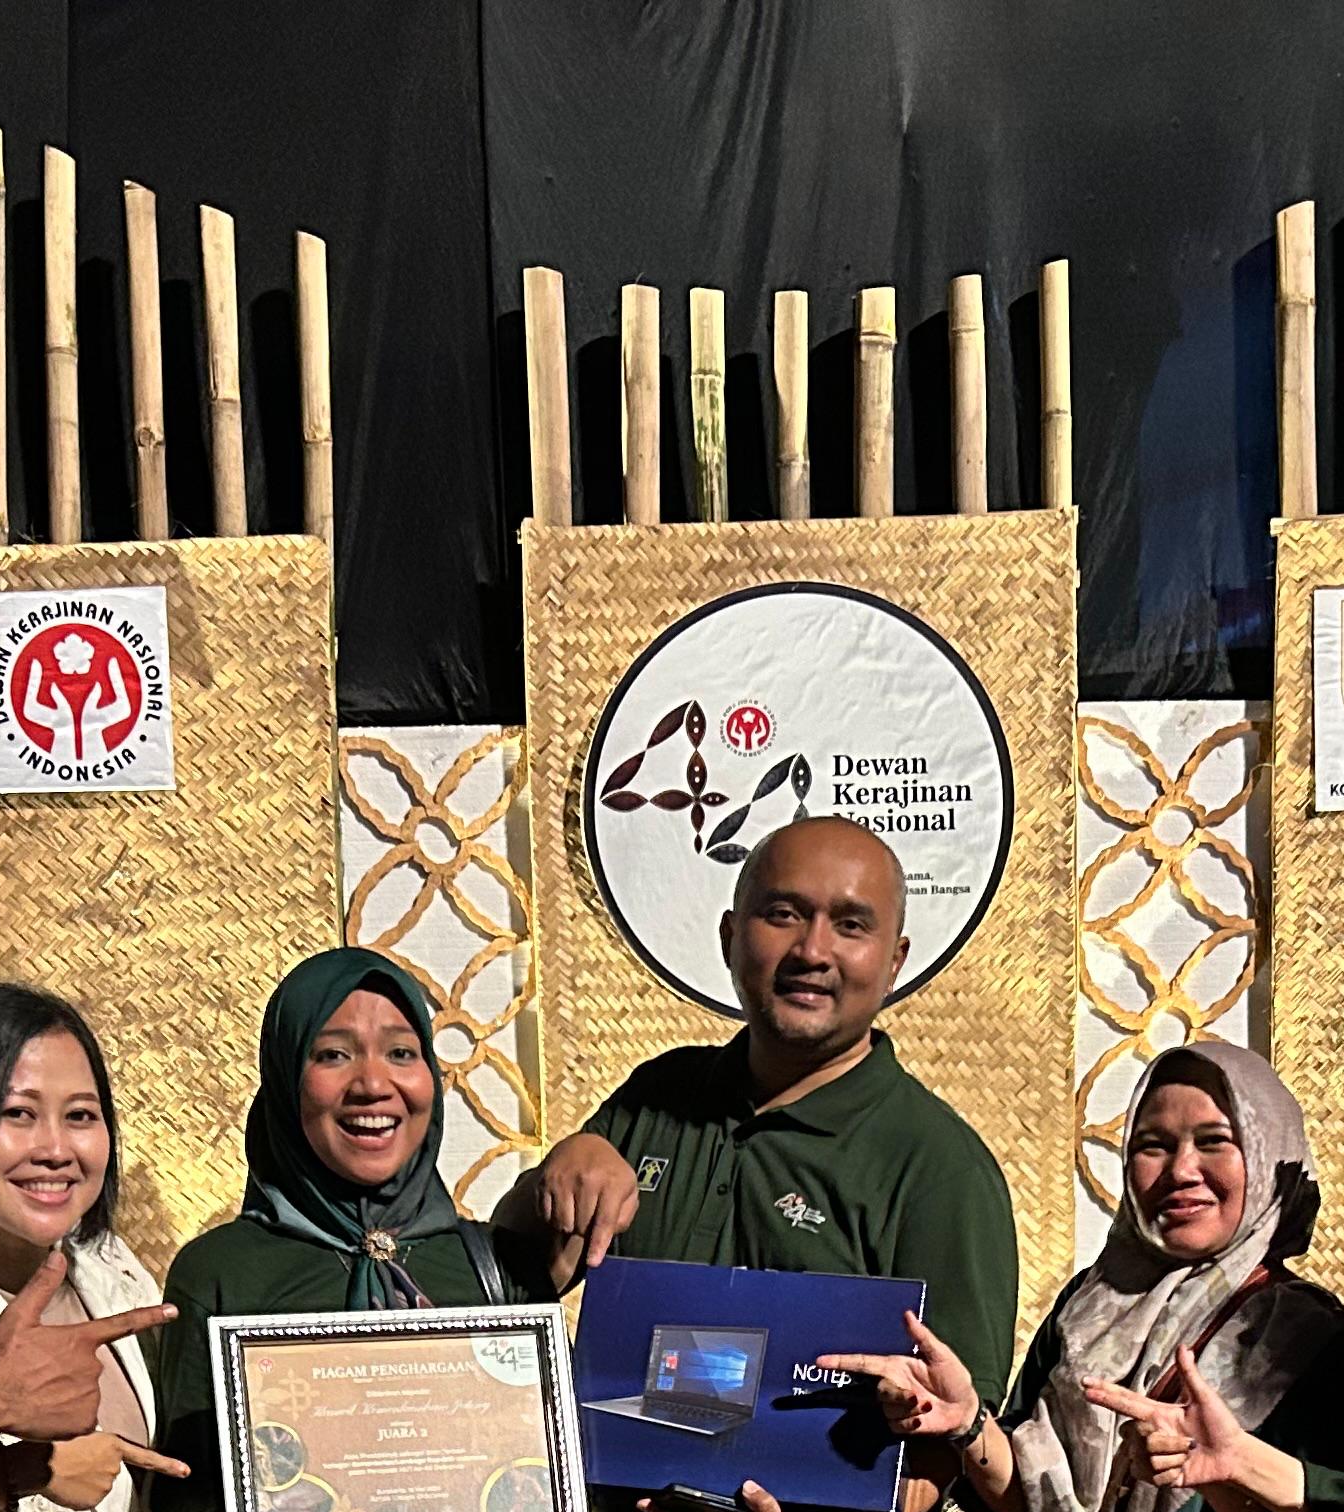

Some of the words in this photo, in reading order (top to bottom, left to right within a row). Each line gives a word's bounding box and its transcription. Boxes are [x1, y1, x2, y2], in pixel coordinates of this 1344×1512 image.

[6, 601, 114, 645] KERAJINAN
[116, 620, 164, 721] NASIONAL
[18, 747, 137, 782] INDONESIA
[832, 754, 929, 777] Dewan
[832, 779, 973, 809] Kerajinan
[312, 1364, 367, 1380] PIAGAM
[370, 1359, 476, 1377] PENGHARGAAN
[376, 1427, 418, 1442] JUARA
